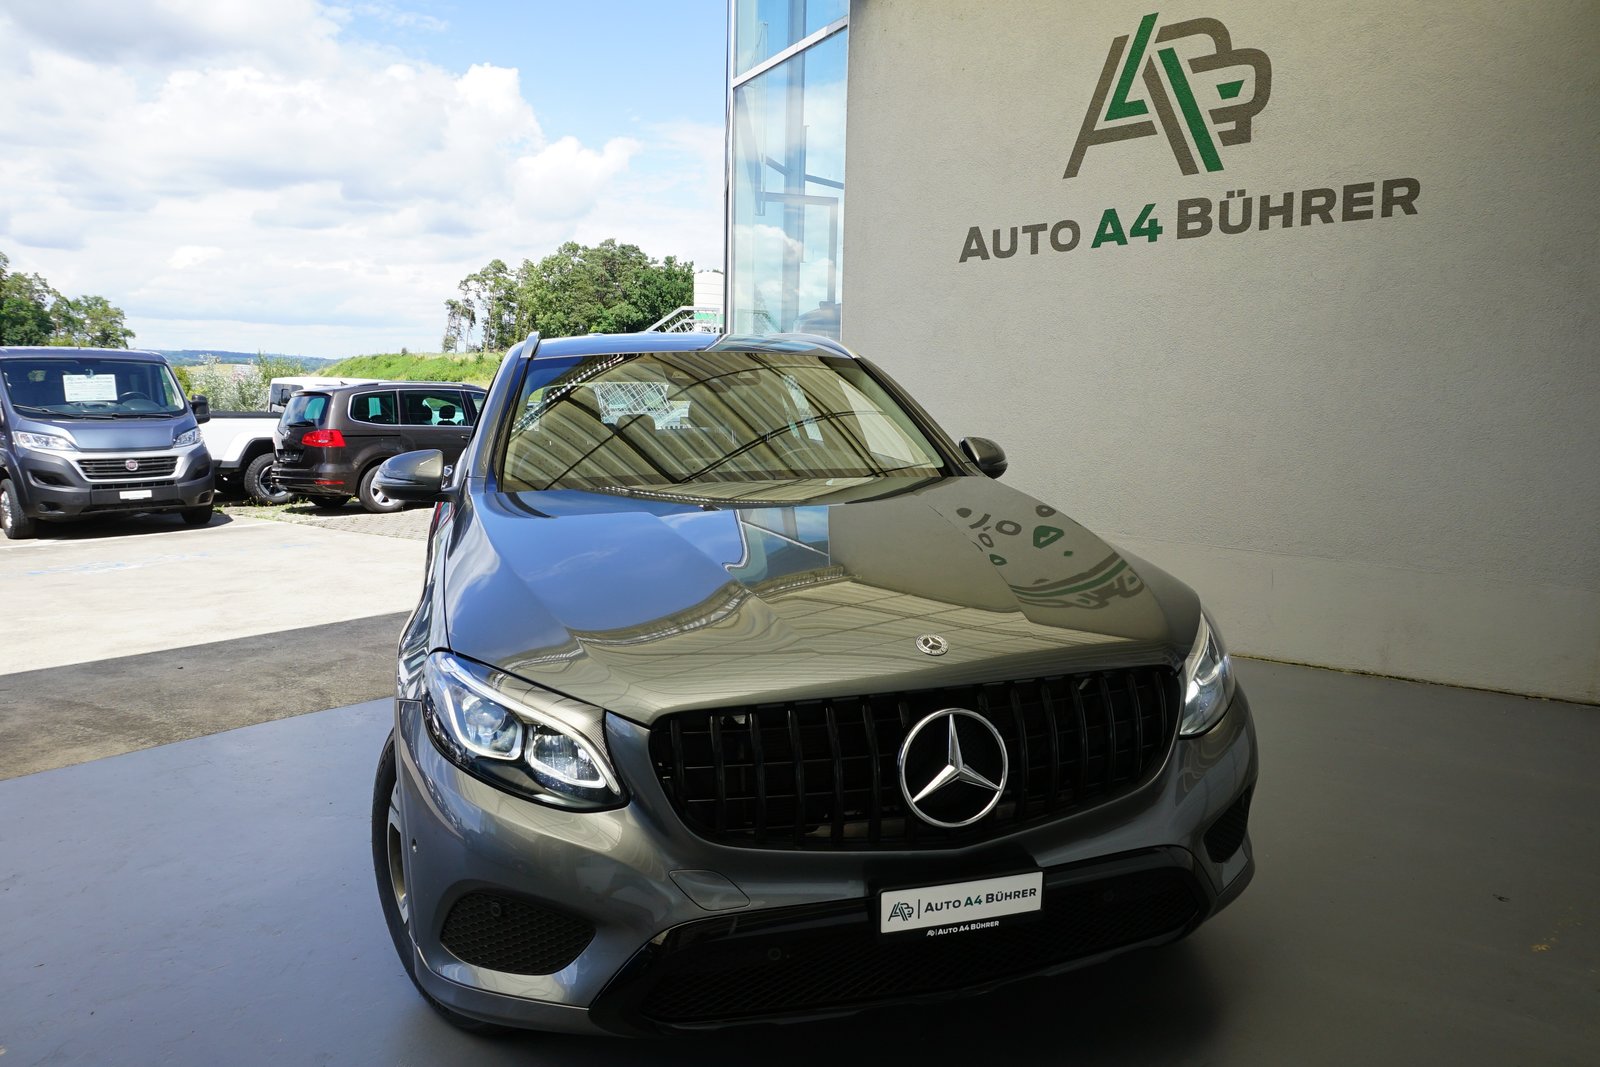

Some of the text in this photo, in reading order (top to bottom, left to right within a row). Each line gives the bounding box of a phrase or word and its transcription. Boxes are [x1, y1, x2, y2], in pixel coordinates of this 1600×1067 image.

[958, 176, 1421, 263] AUTO A4 BÜHRER
[924, 899, 962, 913] AUTO
[963, 894, 983, 908] A4
[985, 887, 1037, 904] BÜHRER
[938, 926, 958, 935] AUTO
[959, 924, 970, 932] A4
[970, 920, 999, 930] BÜHRER
